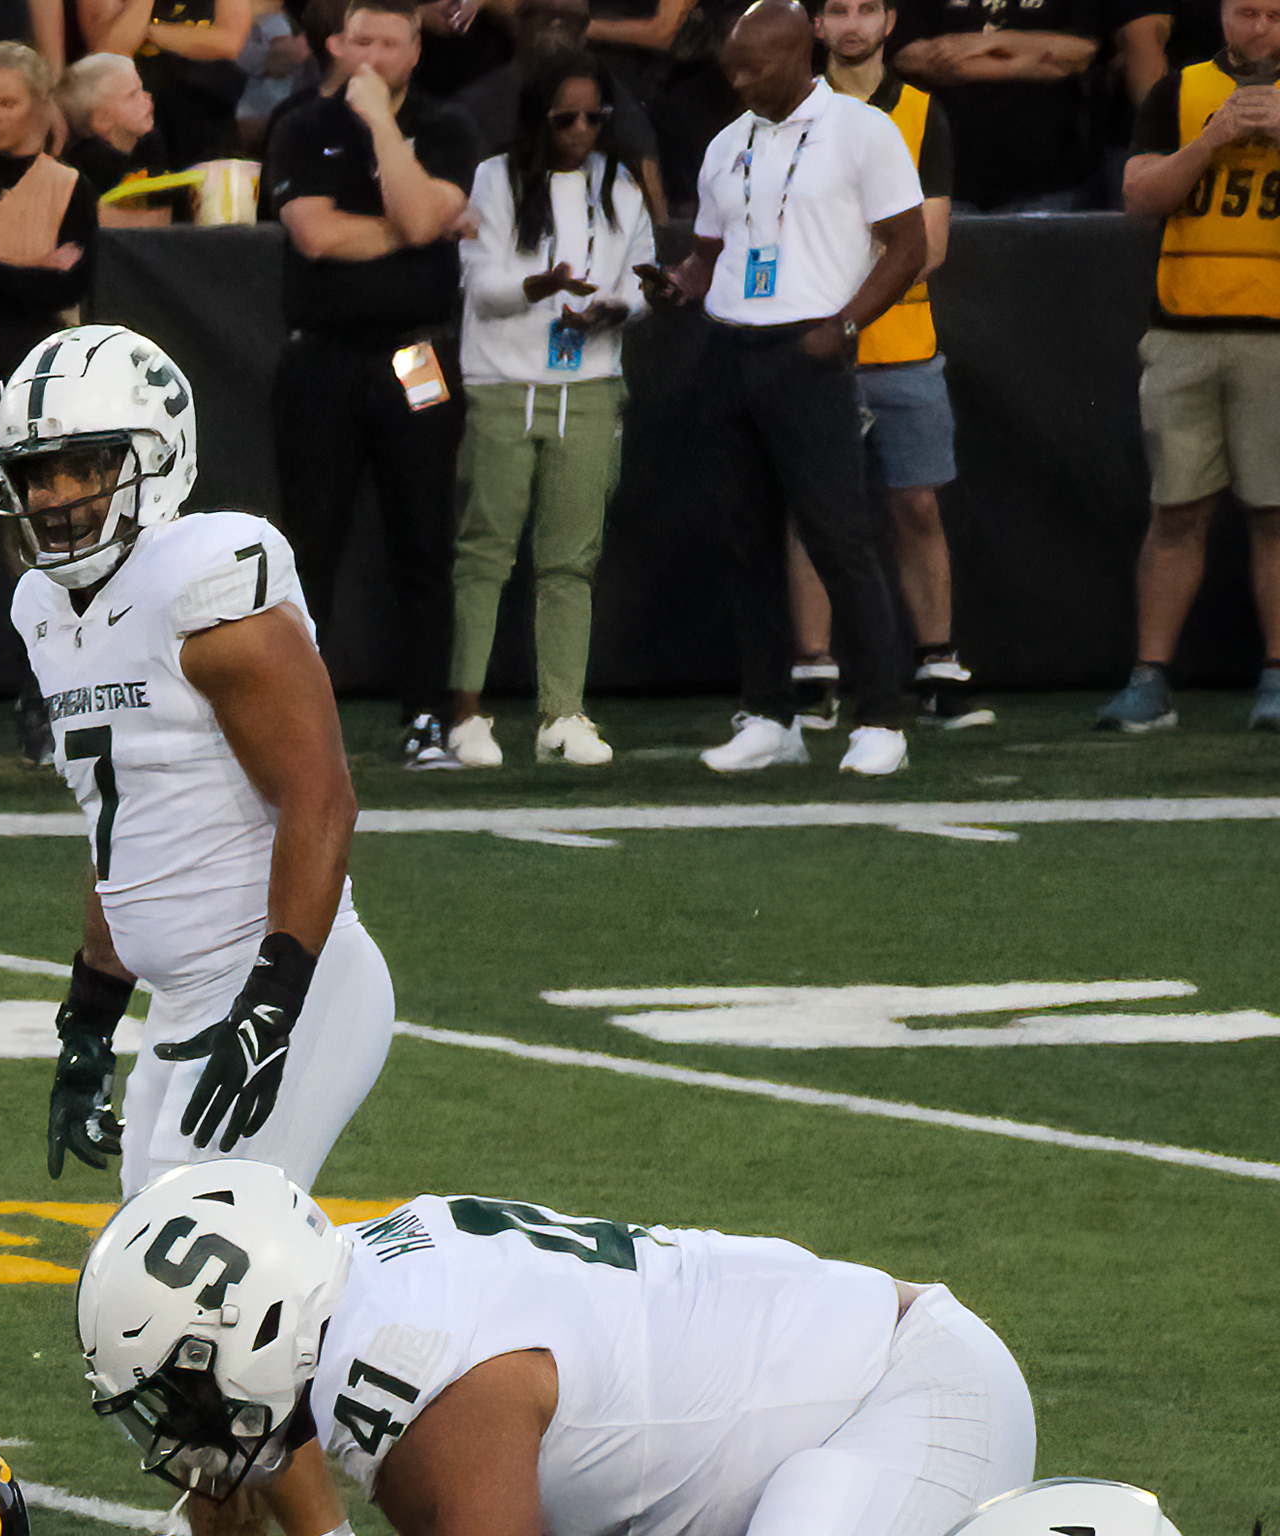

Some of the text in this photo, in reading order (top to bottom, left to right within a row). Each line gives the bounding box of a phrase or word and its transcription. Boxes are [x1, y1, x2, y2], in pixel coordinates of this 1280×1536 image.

[233, 542, 269, 611] 7
[94, 680, 151, 711] STATE
[64, 724, 120, 882] 7
[143, 1214, 251, 1310] S
[333, 1357, 422, 1456] 41
